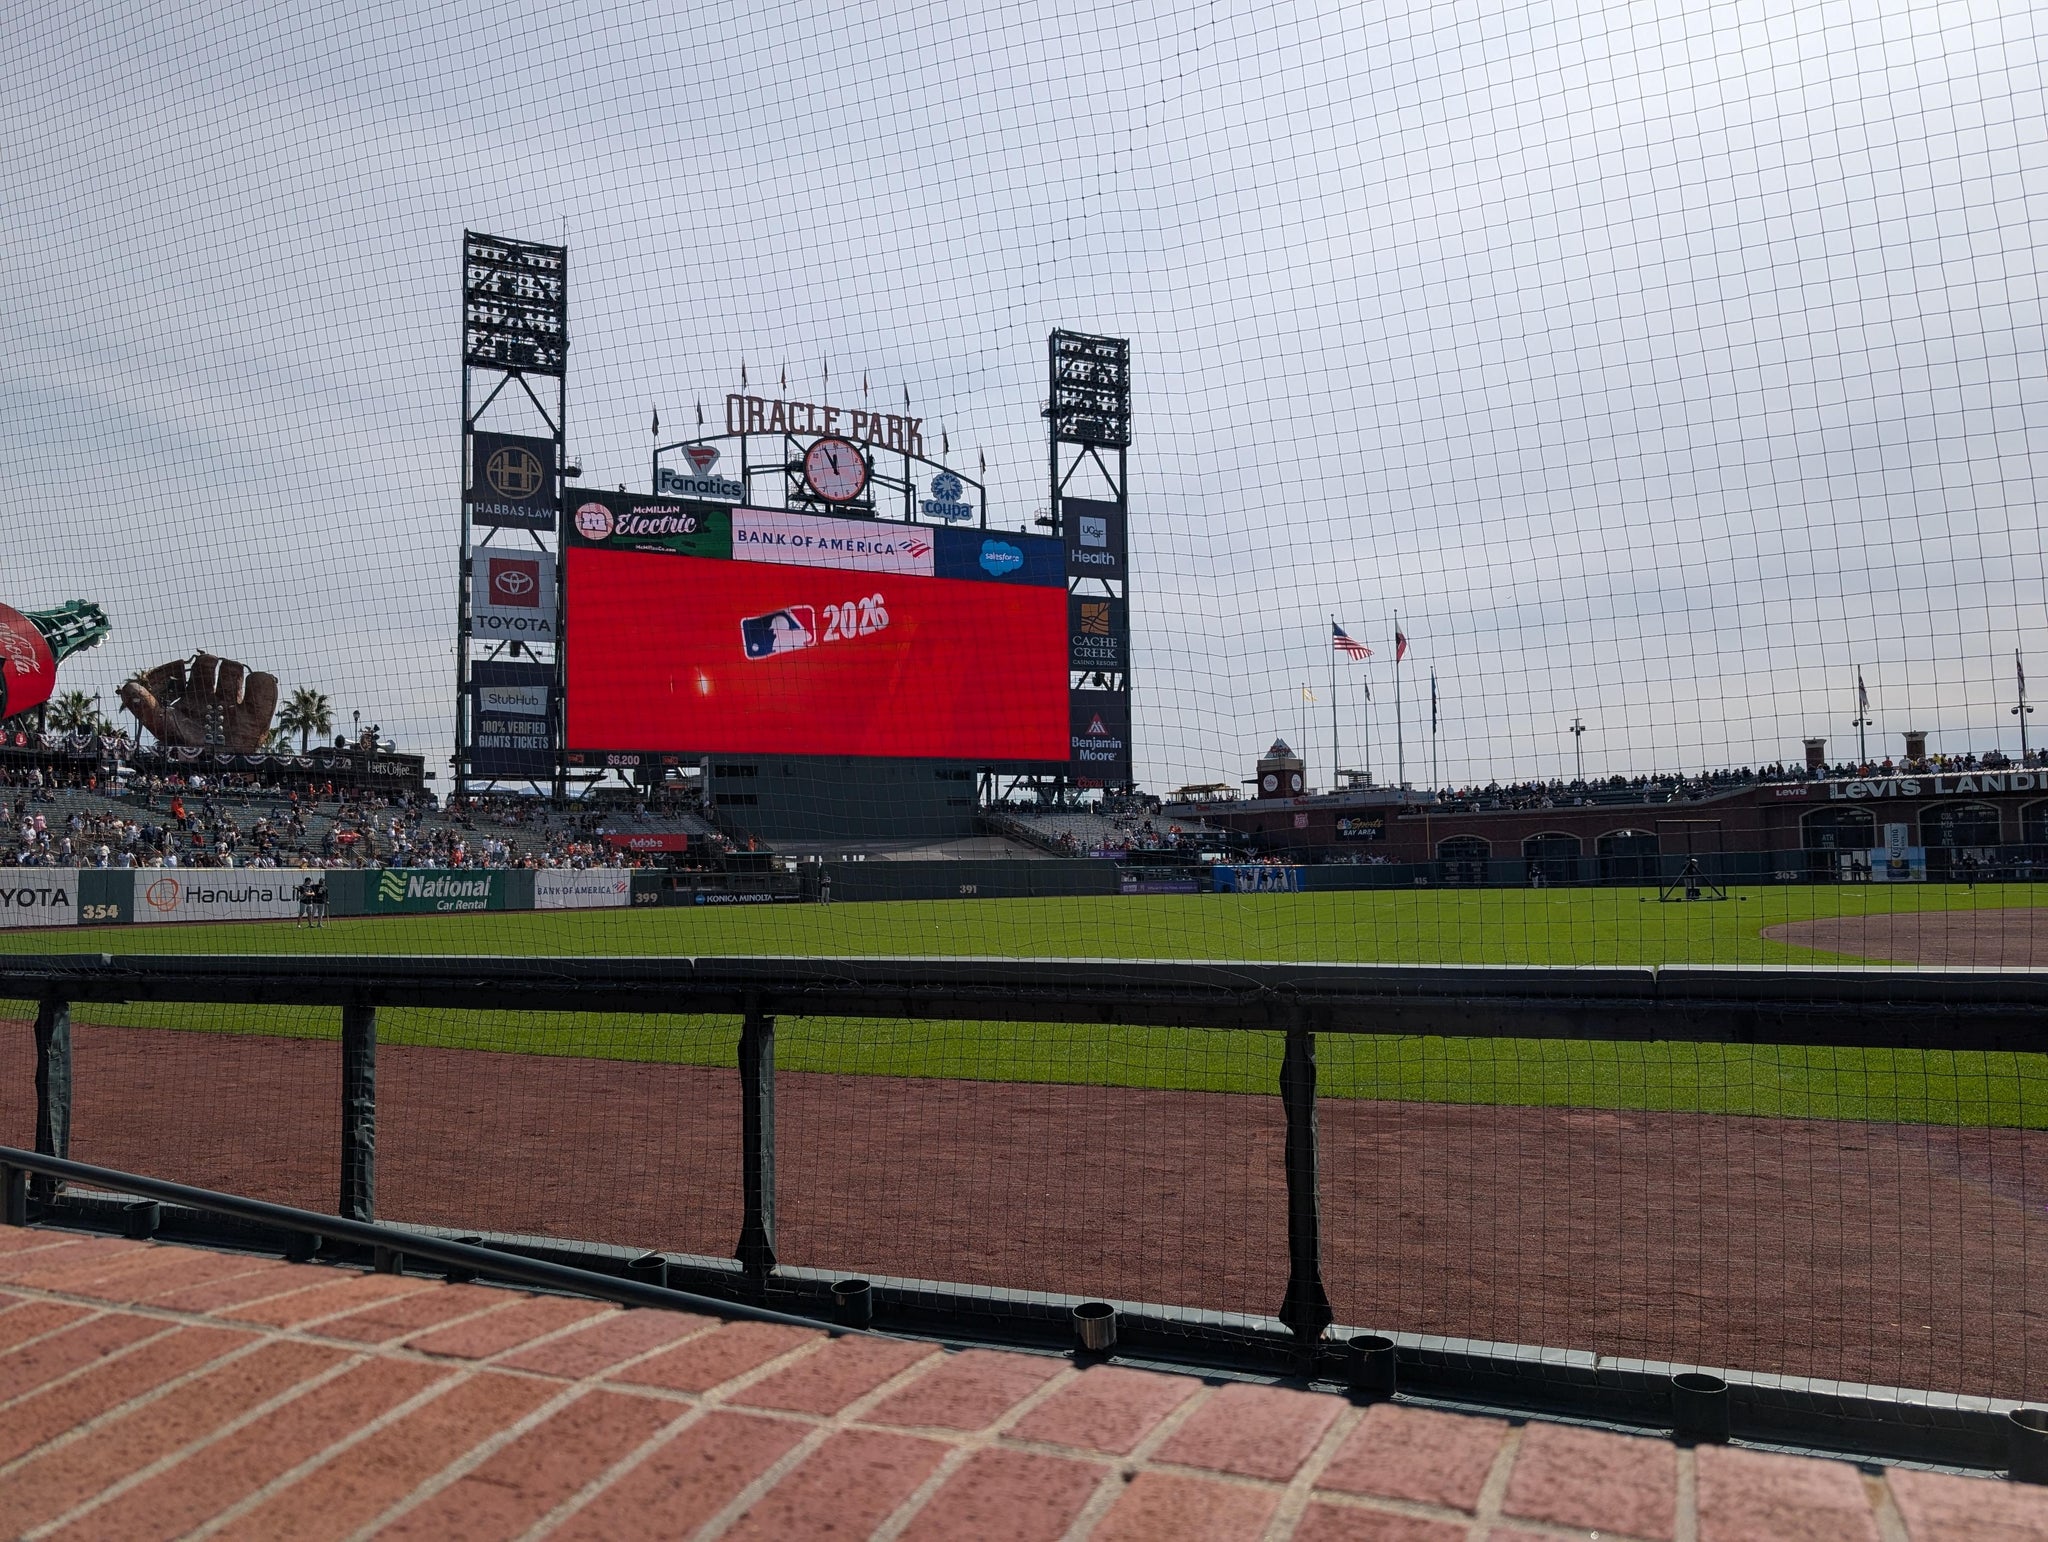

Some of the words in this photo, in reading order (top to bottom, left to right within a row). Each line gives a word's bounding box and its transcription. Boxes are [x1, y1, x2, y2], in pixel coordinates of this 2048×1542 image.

[726, 394, 840, 436] ORACLE
[851, 410, 924, 459] PARK
[662, 472, 742, 496] Fanatics
[476, 503, 524, 516] HABBAS
[528, 506, 554, 519] LAW
[633, 506, 680, 514] McMILLAN
[926, 501, 969, 519] coupa
[616, 514, 696, 534] Electric
[1082, 525, 1104, 538] UCSF
[738, 530, 786, 545] BANK
[792, 535, 813, 547] OF
[818, 538, 894, 555] AMERICA
[985, 552, 1019, 562] salesforce
[1072, 550, 1115, 565] Health
[477, 616, 551, 632] TOYOTA
[823, 593, 890, 642] 2026
[1072, 636, 1118, 648] CACHE
[1074, 648, 1116, 659] CREEK
[488, 694, 539, 705] StubHub
[482, 720, 505, 733] 100%
[508, 721, 546, 734] VERIFIED
[479, 736, 510, 748] GIANTS
[513, 736, 549, 749] TICKETS
[1072, 736, 1122, 750] Benjamin
[608, 754, 640, 766] $6,200
[1080, 750, 1115, 760] Moore
[387, 762, 410, 777] Coffee
[1351, 818, 1383, 829] Sports
[630, 838, 663, 848] Adobe
[1776, 871, 1798, 879] 365
[408, 875, 492, 898] National
[538, 887, 561, 895] BANK
[960, 885, 976, 893] 391
[186, 886, 272, 904] Hanwha
[280, 886, 301, 902] Li
[636, 893, 658, 903] 399
[437, 900, 454, 910] Car
[456, 899, 487, 910] Rental
[83, 904, 118, 919] 354
